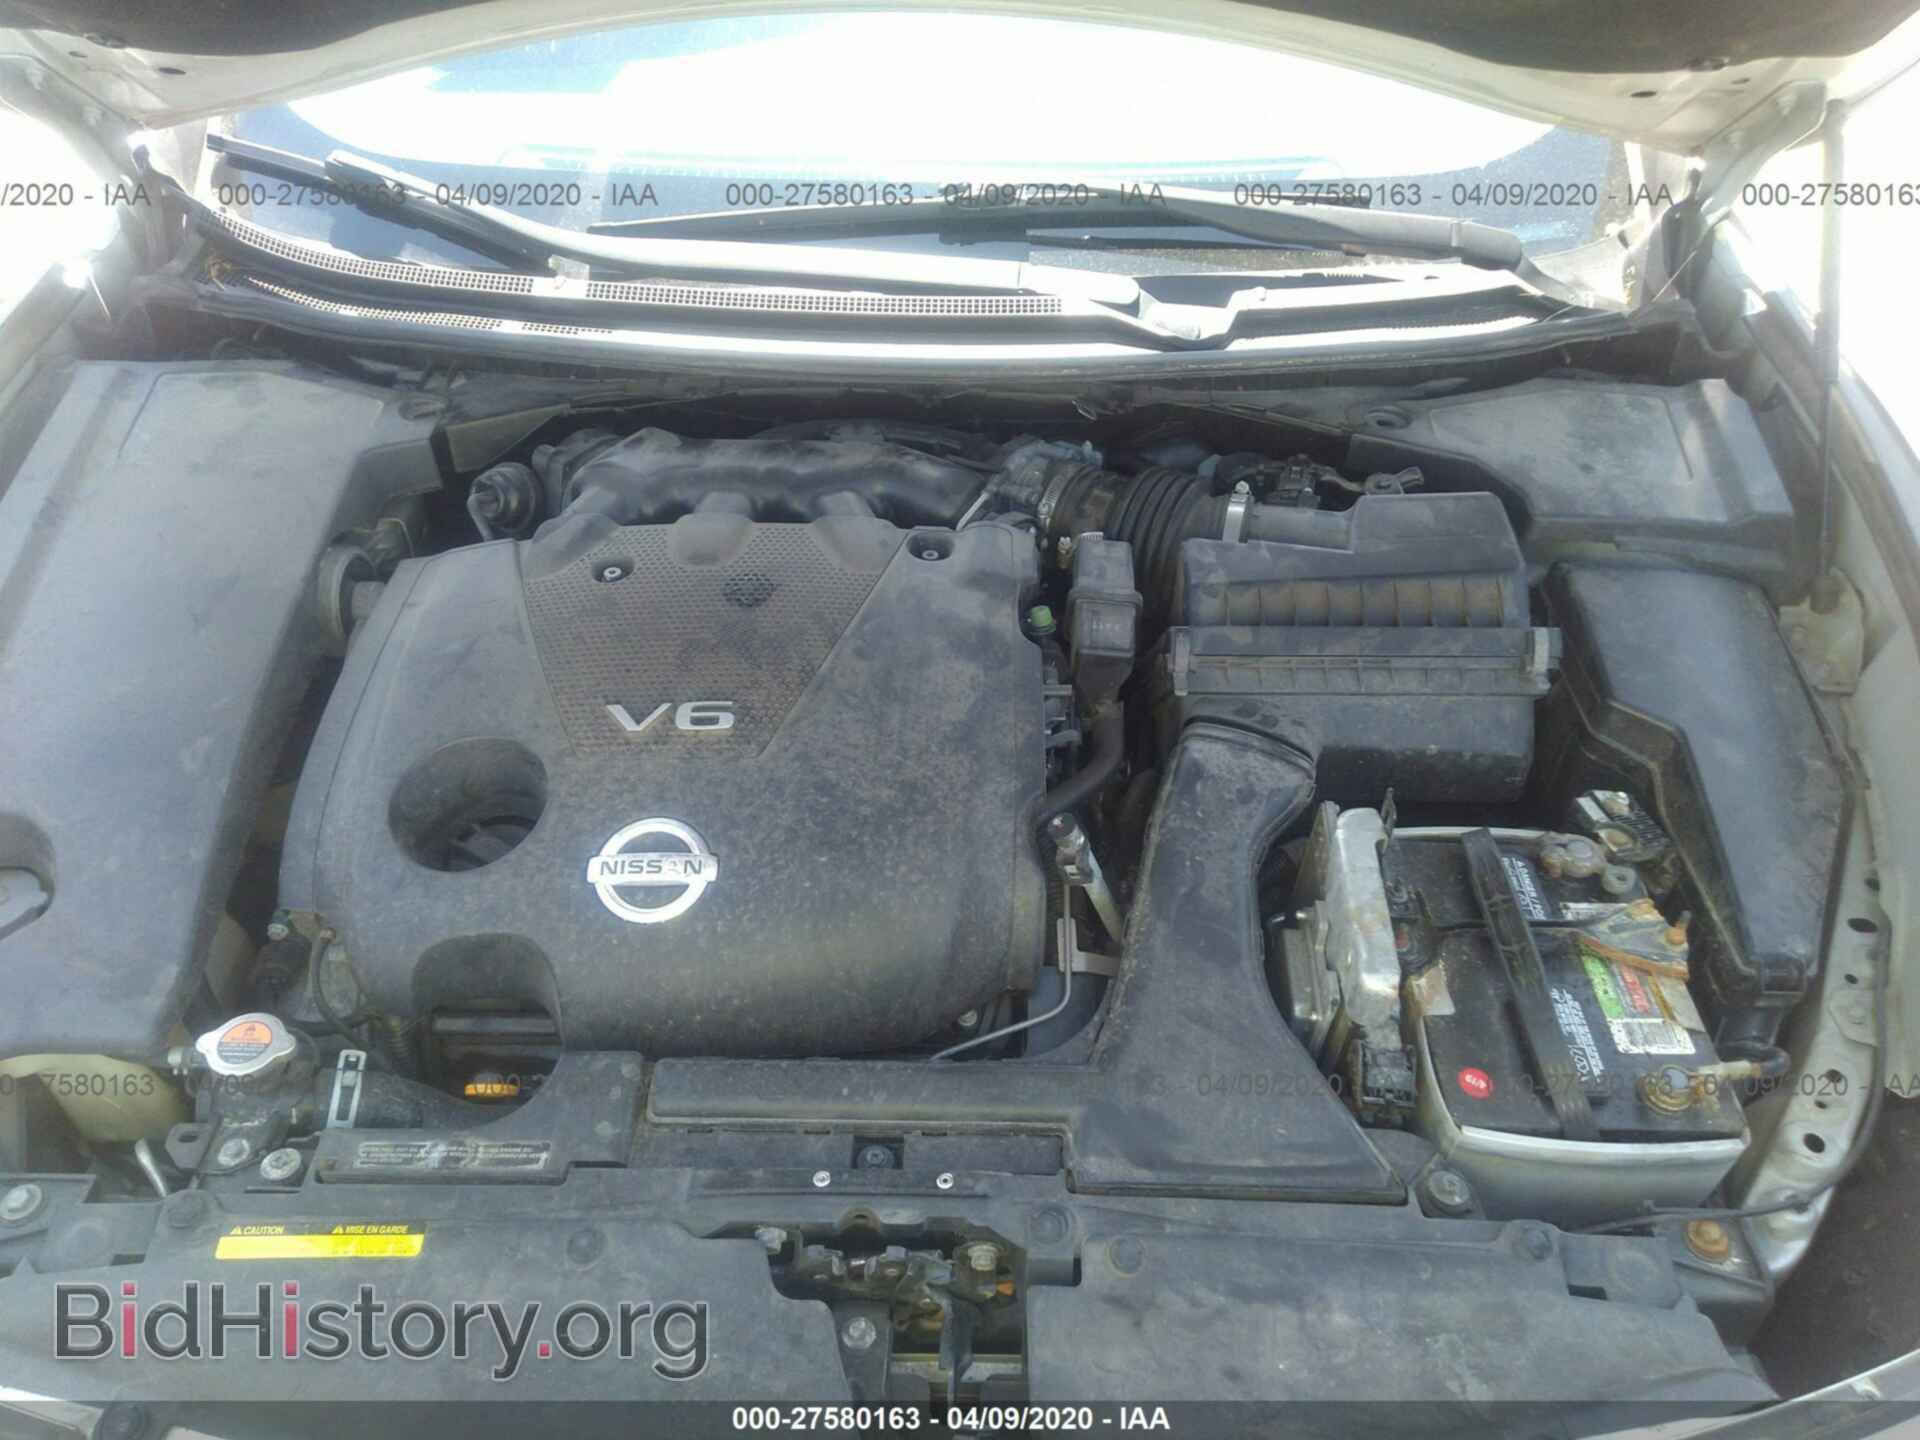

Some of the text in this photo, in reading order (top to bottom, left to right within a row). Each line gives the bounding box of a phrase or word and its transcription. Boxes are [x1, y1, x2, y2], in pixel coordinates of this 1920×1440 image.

[606, 700, 735, 731] V6
[600, 859, 702, 876] NISSN
[243, 1225, 284, 1234] CAUTION
[344, 1224, 408, 1234] MISE EN GARDE
